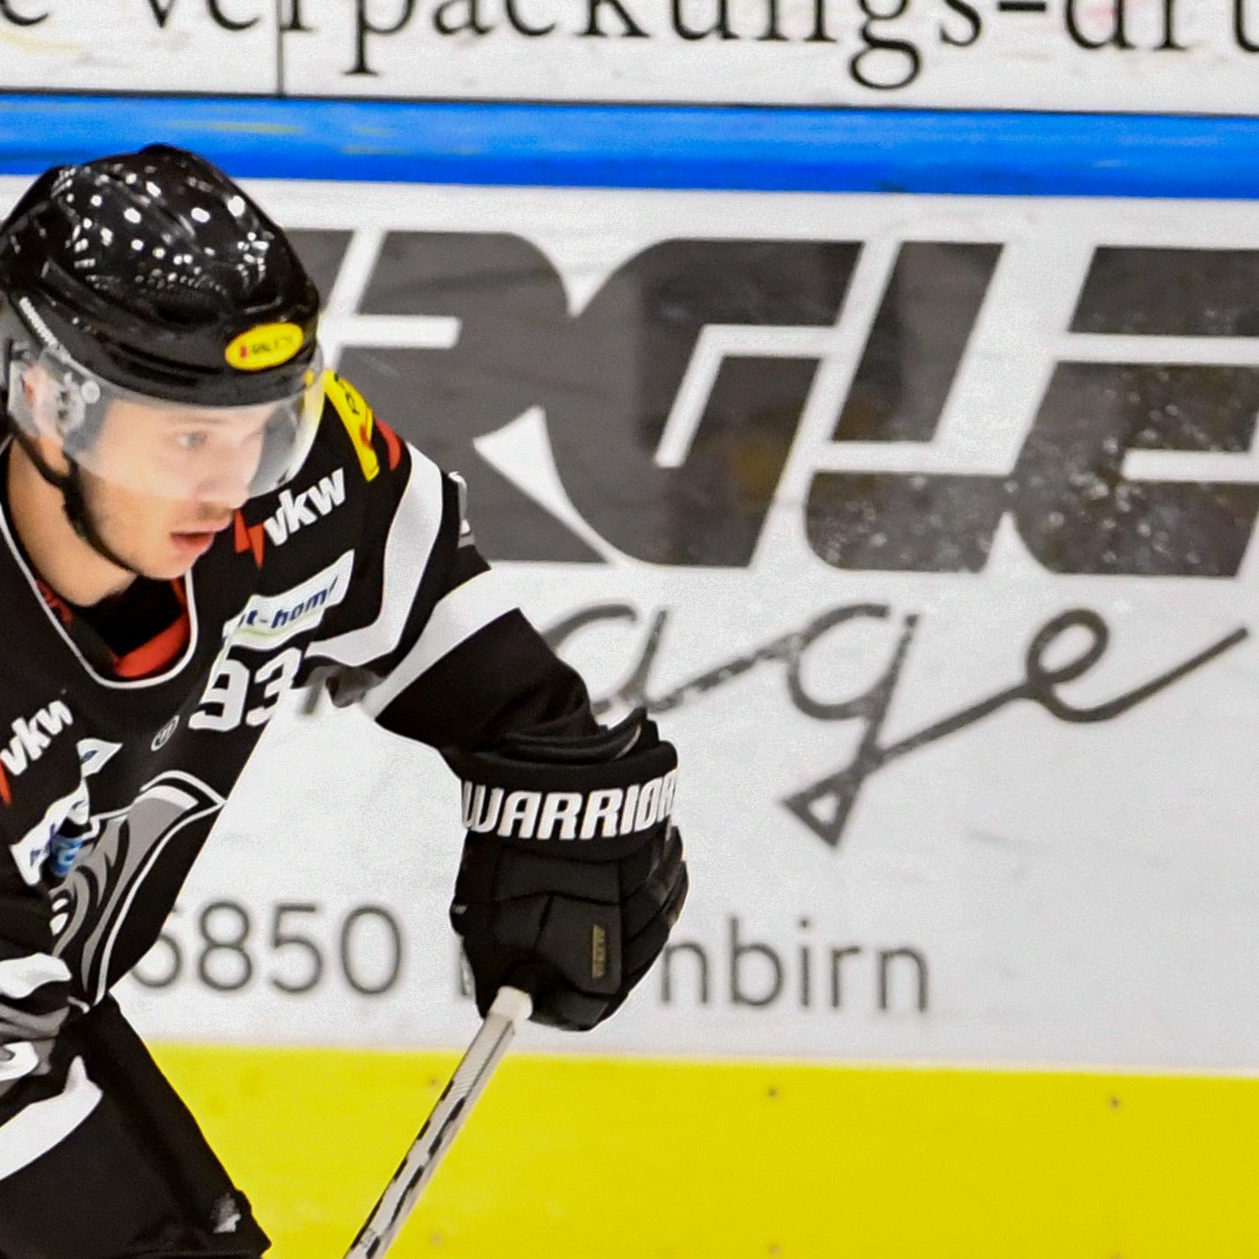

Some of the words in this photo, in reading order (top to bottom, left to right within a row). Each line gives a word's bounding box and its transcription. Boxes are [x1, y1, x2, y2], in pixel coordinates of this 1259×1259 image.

[263, 467, 346, 547] vkw
[188, 647, 303, 732] 93
[539, 603, 1251, 848] age
[461, 768, 679, 841] WARRIOR
[451, 915, 930, 1013] nbirn
